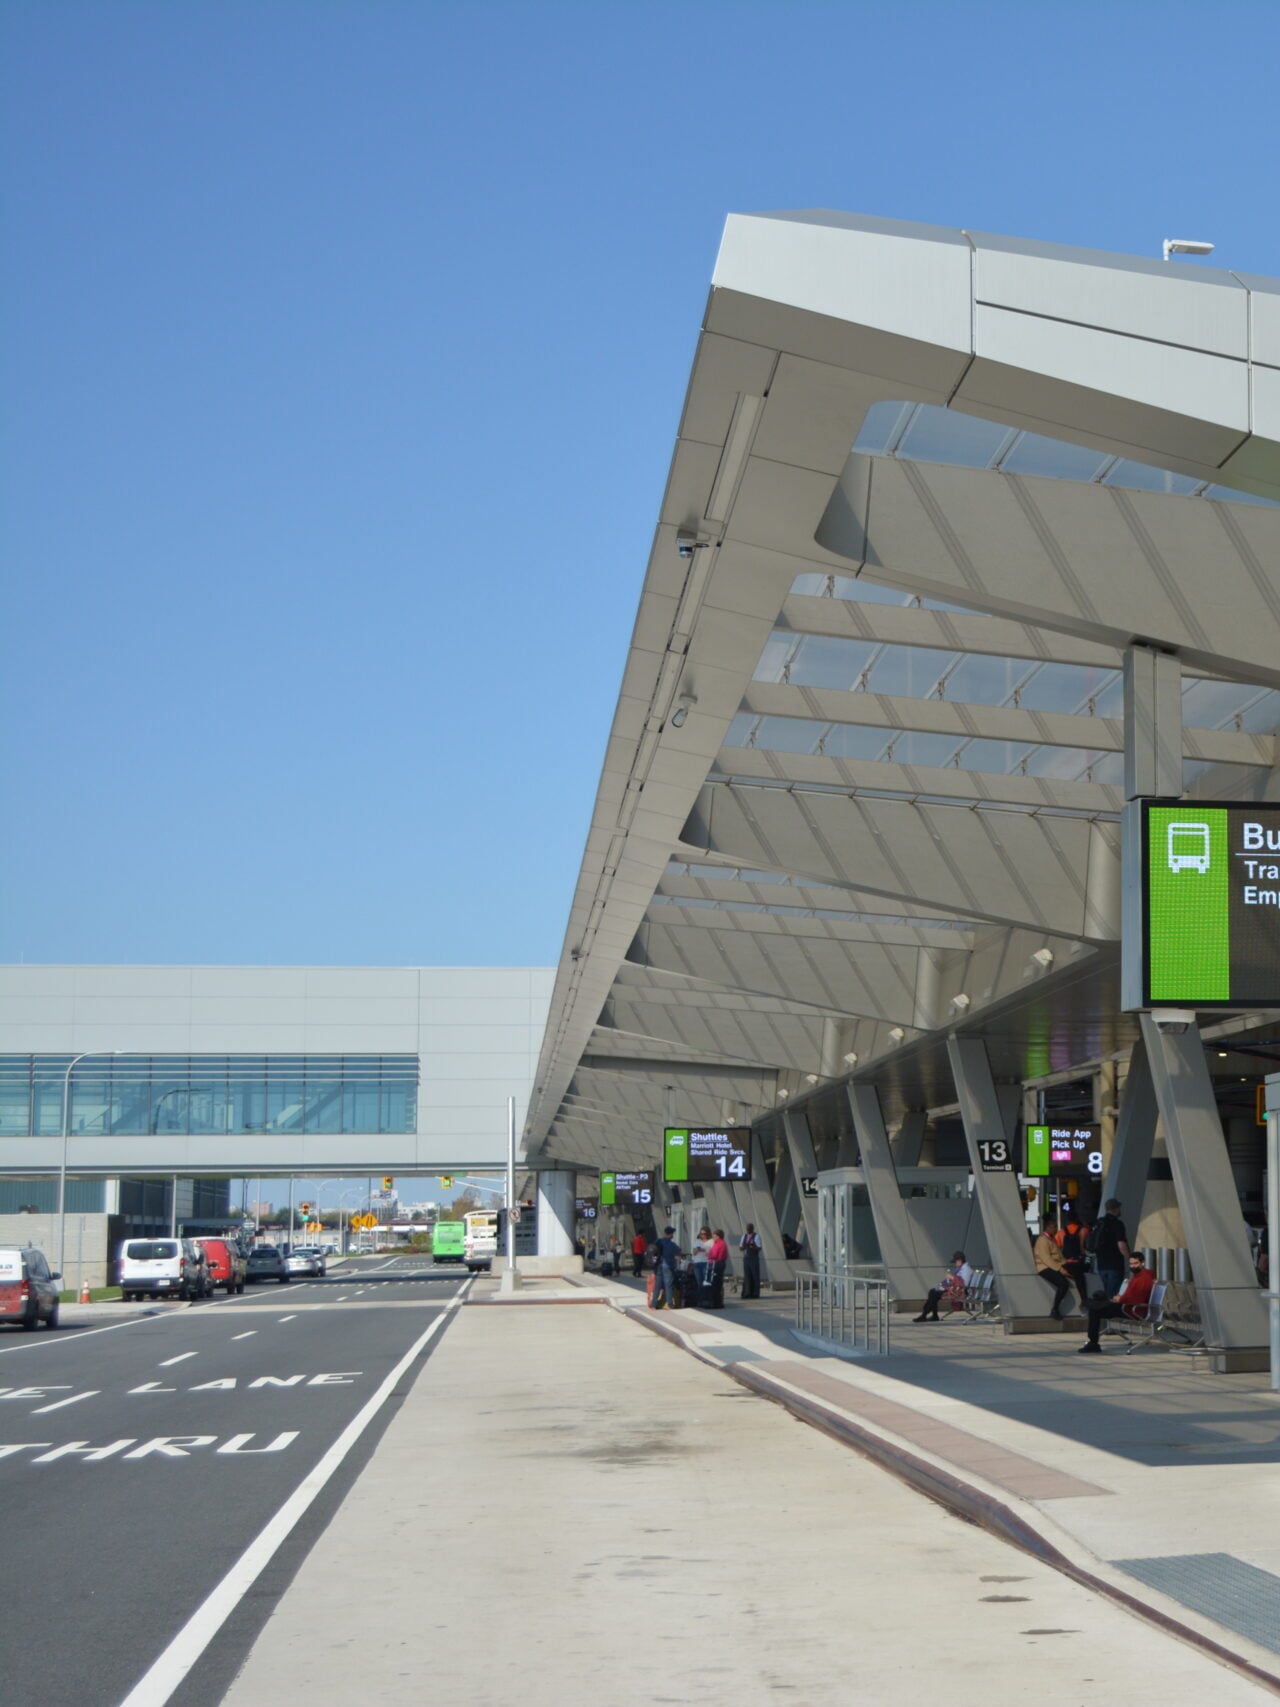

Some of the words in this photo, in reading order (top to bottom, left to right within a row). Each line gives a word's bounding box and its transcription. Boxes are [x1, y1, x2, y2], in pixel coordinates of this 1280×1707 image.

[690, 1132, 728, 1141] Shuttles
[1052, 1129, 1071, 1138] Ride
[1074, 1129, 1091, 1139] App
[980, 1141, 1007, 1162] 13
[1052, 1140, 1070, 1149] Pick
[1073, 1140, 1085, 1150] Up
[715, 1155, 746, 1178] 14
[1087, 1151, 1103, 1174] 8
[802, 1178, 818, 1192] 14
[632, 1189, 652, 1204] 15
[583, 1207, 596, 1218] 16
[1062, 1202, 1071, 1211] 4
[127, 1371, 364, 1394] LANE
[0, 1386, 73, 1398] E
[0, 1431, 300, 1462] THRU
